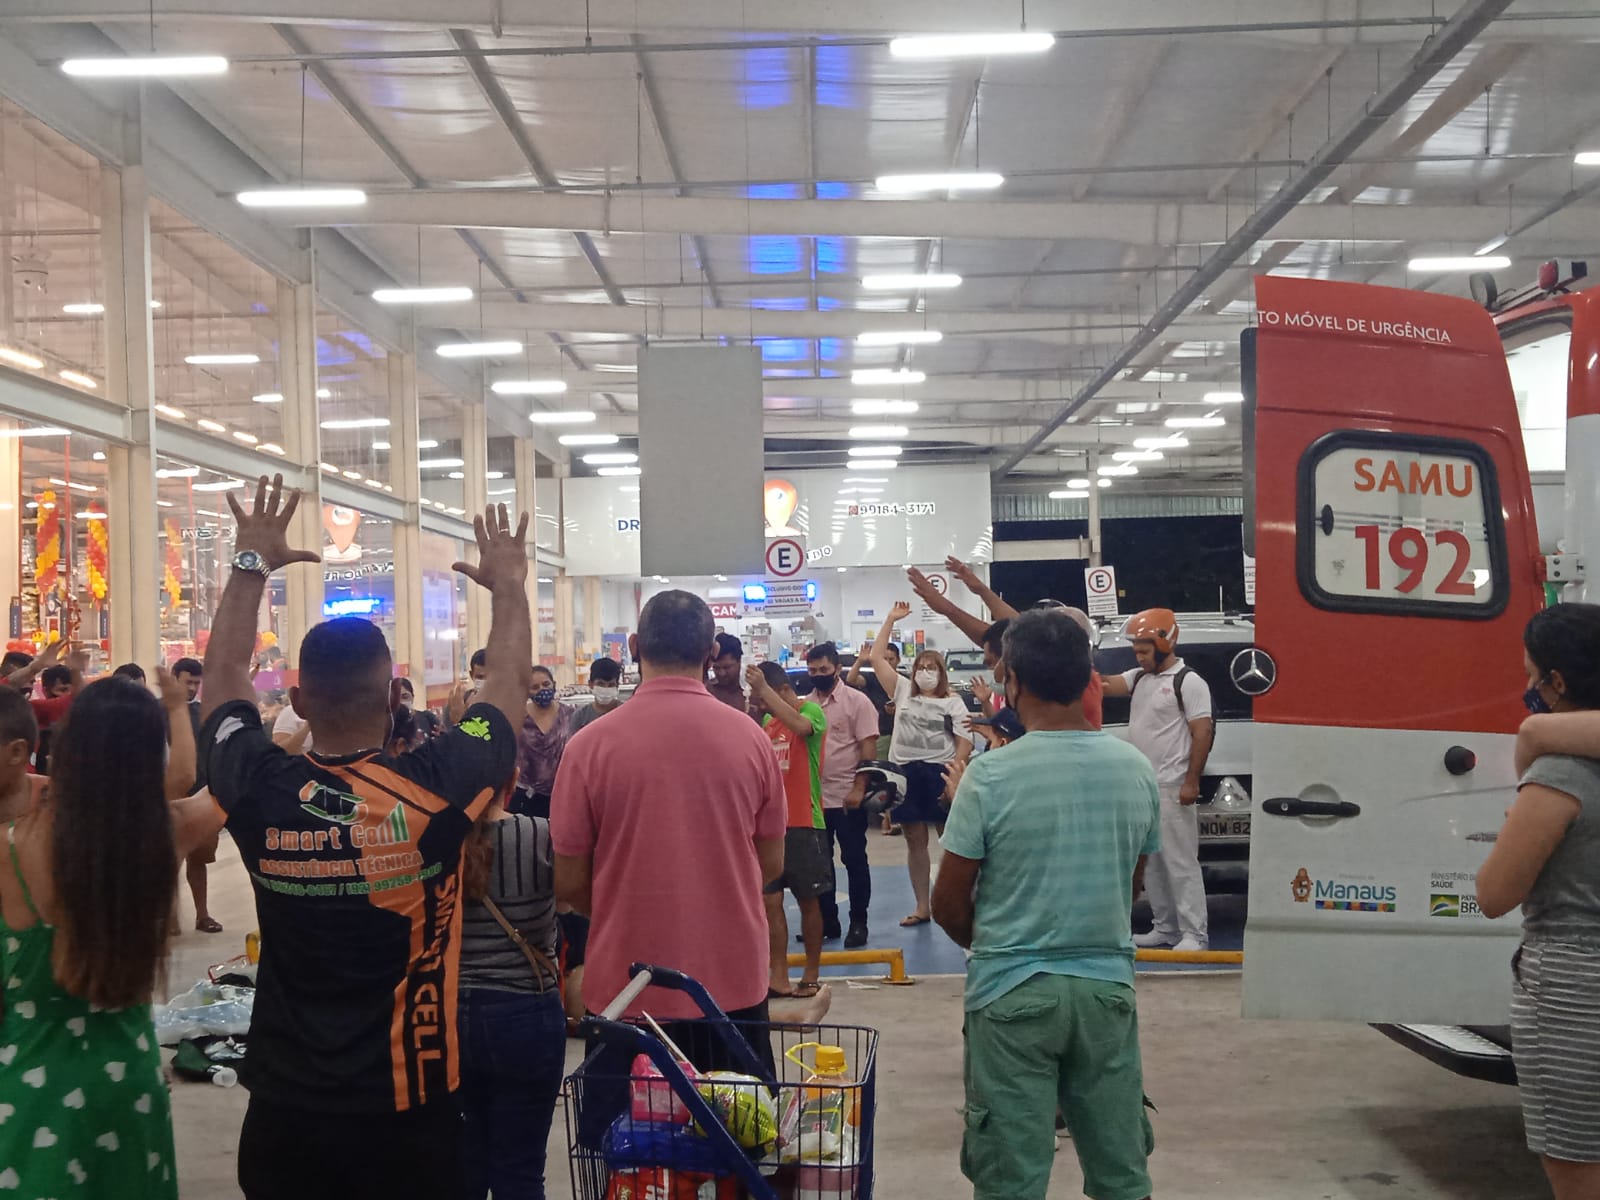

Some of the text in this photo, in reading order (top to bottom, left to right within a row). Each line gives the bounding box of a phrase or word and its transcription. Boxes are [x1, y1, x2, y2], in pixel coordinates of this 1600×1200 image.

[1257, 311, 1452, 343] TO MÓVEL DE URGÊNCIA
[1354, 458, 1473, 497] SAMU
[617, 519, 640, 531] DR
[777, 547, 792, 569] E
[1355, 525, 1475, 596] 192
[1095, 574, 1105, 588] E
[265, 825, 343, 851] Smart
[259, 850, 424, 878] ASSISTÊNCIA TÉCNICA
[1315, 880, 1396, 901] Manaus
[1430, 880, 1454, 888] SAÚDE
[412, 982, 441, 1104] CELL
